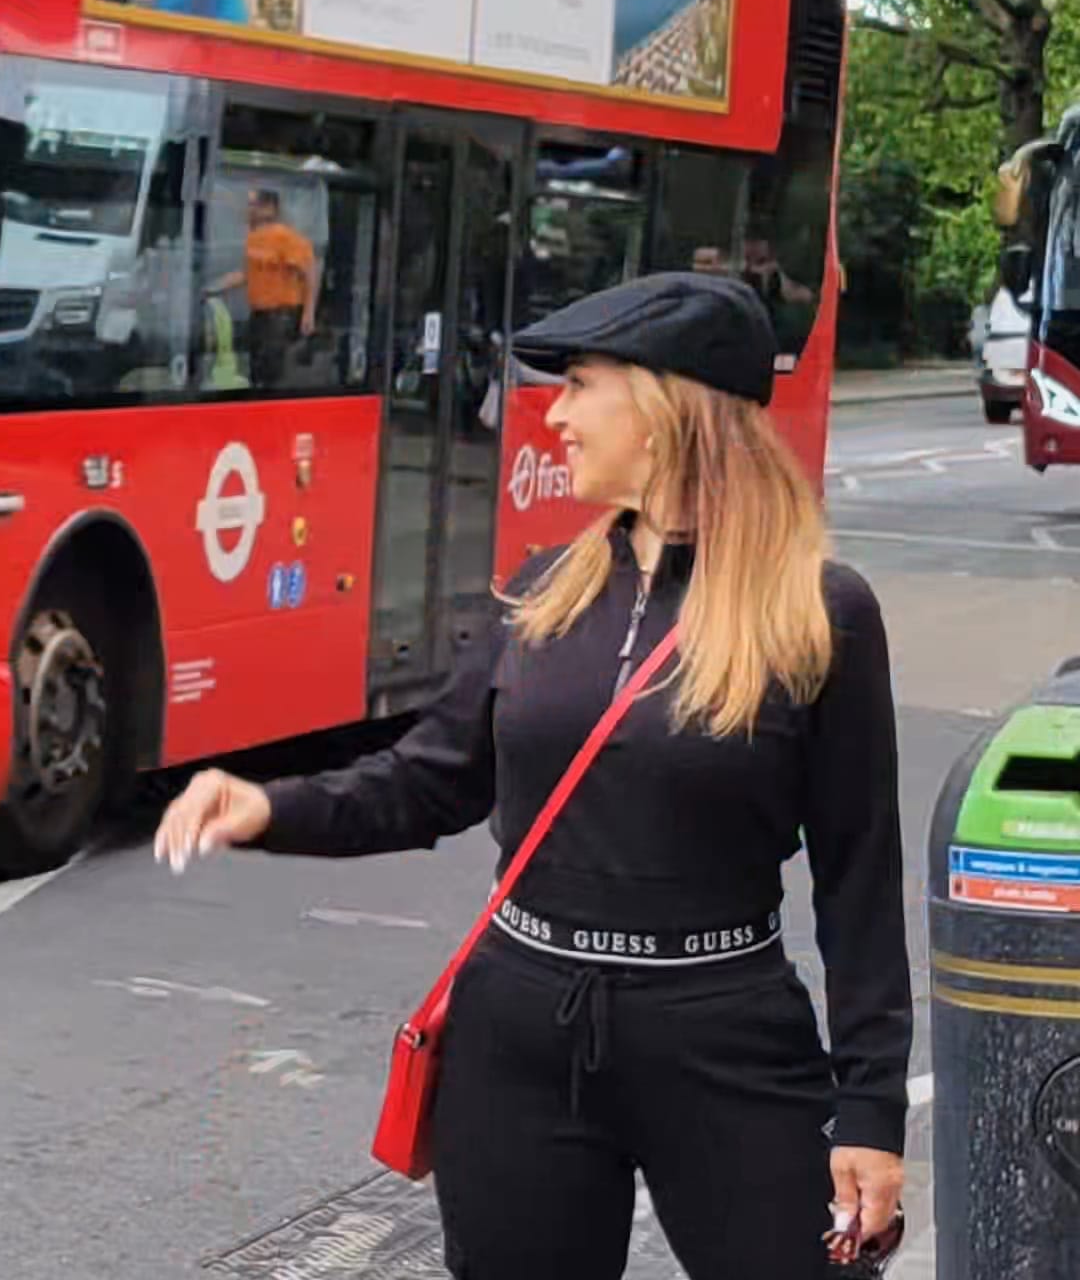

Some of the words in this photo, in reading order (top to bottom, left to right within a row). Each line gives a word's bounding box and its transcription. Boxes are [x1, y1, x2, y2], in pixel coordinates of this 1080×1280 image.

[501, 898, 552, 941] GUESS
[573, 929, 657, 955] GUESS
[684, 924, 754, 954] GUESS
